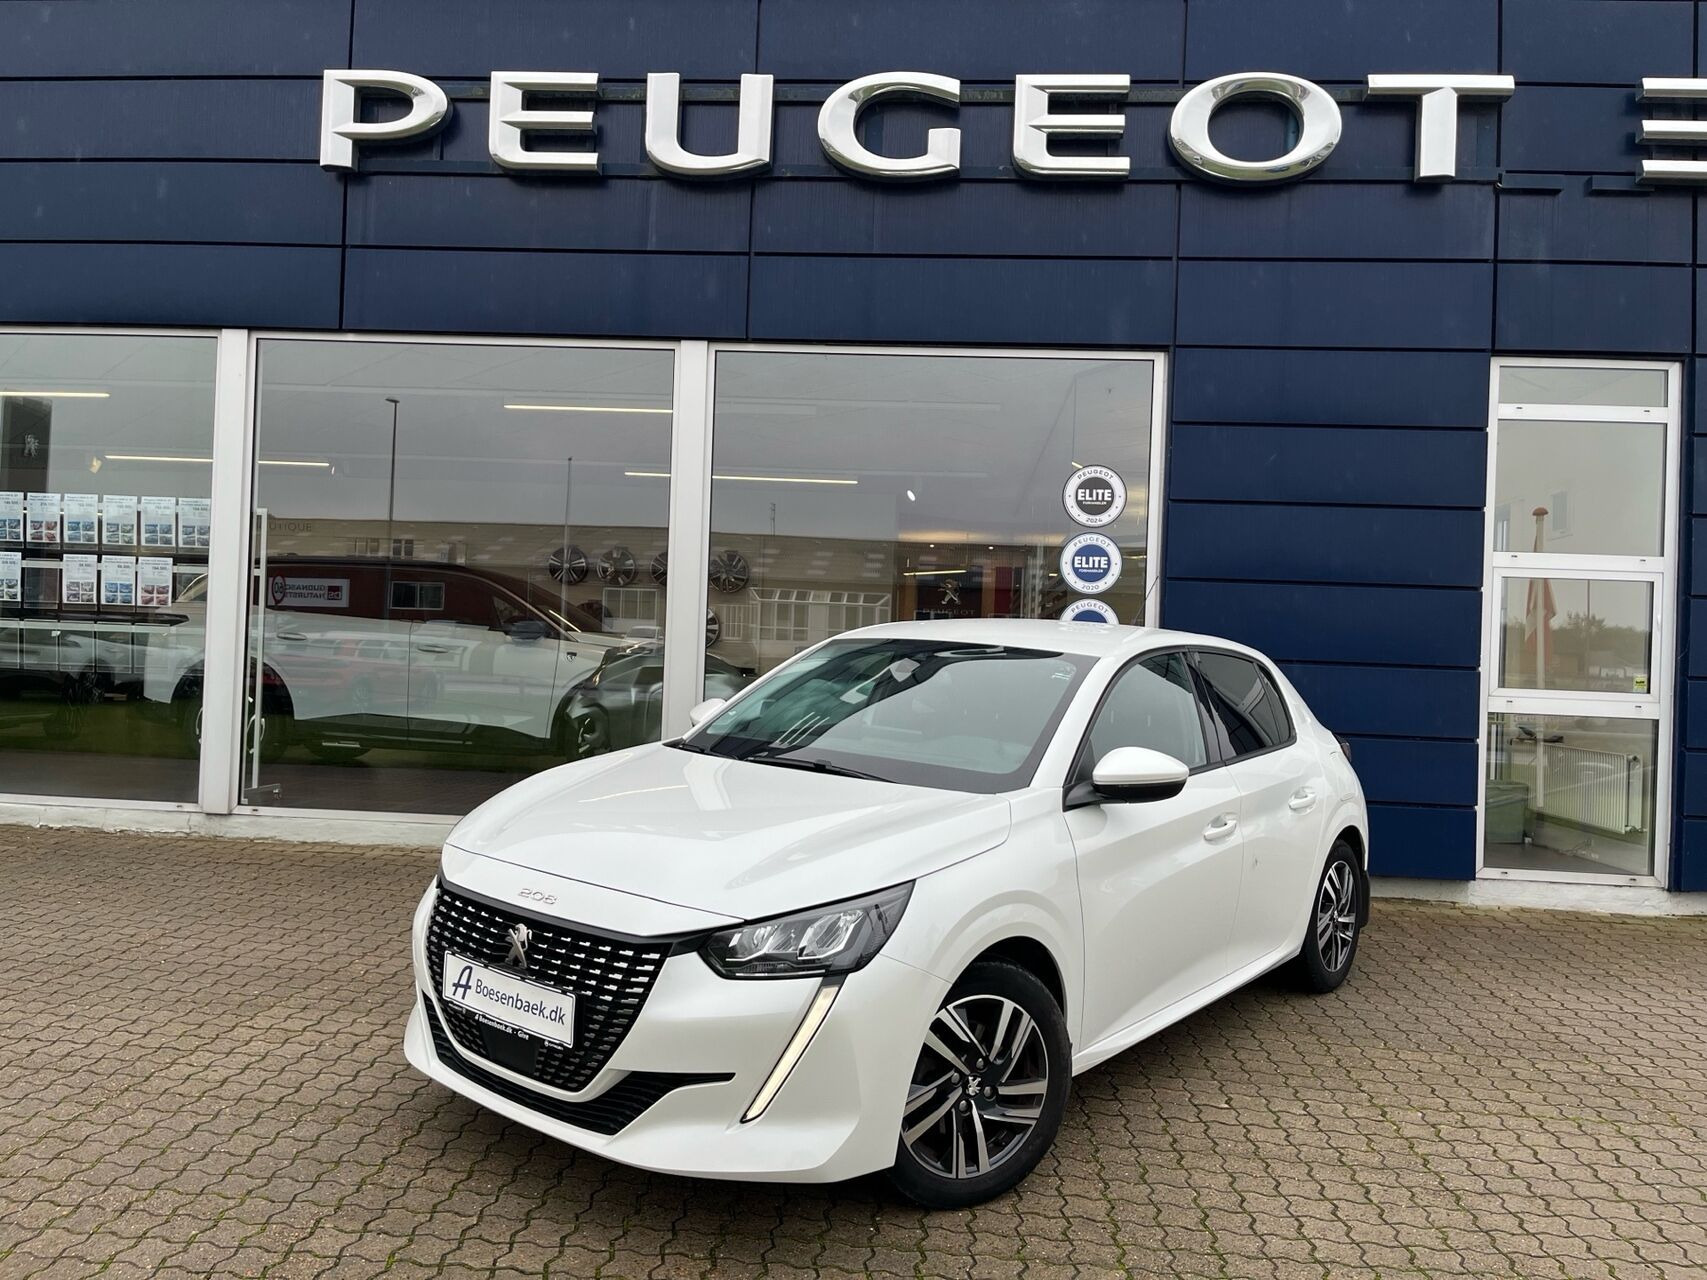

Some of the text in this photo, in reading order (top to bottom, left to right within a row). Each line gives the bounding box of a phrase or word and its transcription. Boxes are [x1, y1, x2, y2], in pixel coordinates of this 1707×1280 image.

[319, 69, 1515, 183] PEUGEOT
[1077, 468, 1114, 480] PEUGEOT
[1077, 488, 1112, 502] ELITE
[1072, 536, 1111, 548] PEUGEOT
[1073, 555, 1108, 569] ELITE
[1070, 603, 1109, 614] PEUGEOT
[517, 888, 558, 905] 208
[475, 978, 567, 1025] Boesenbaek.dk
